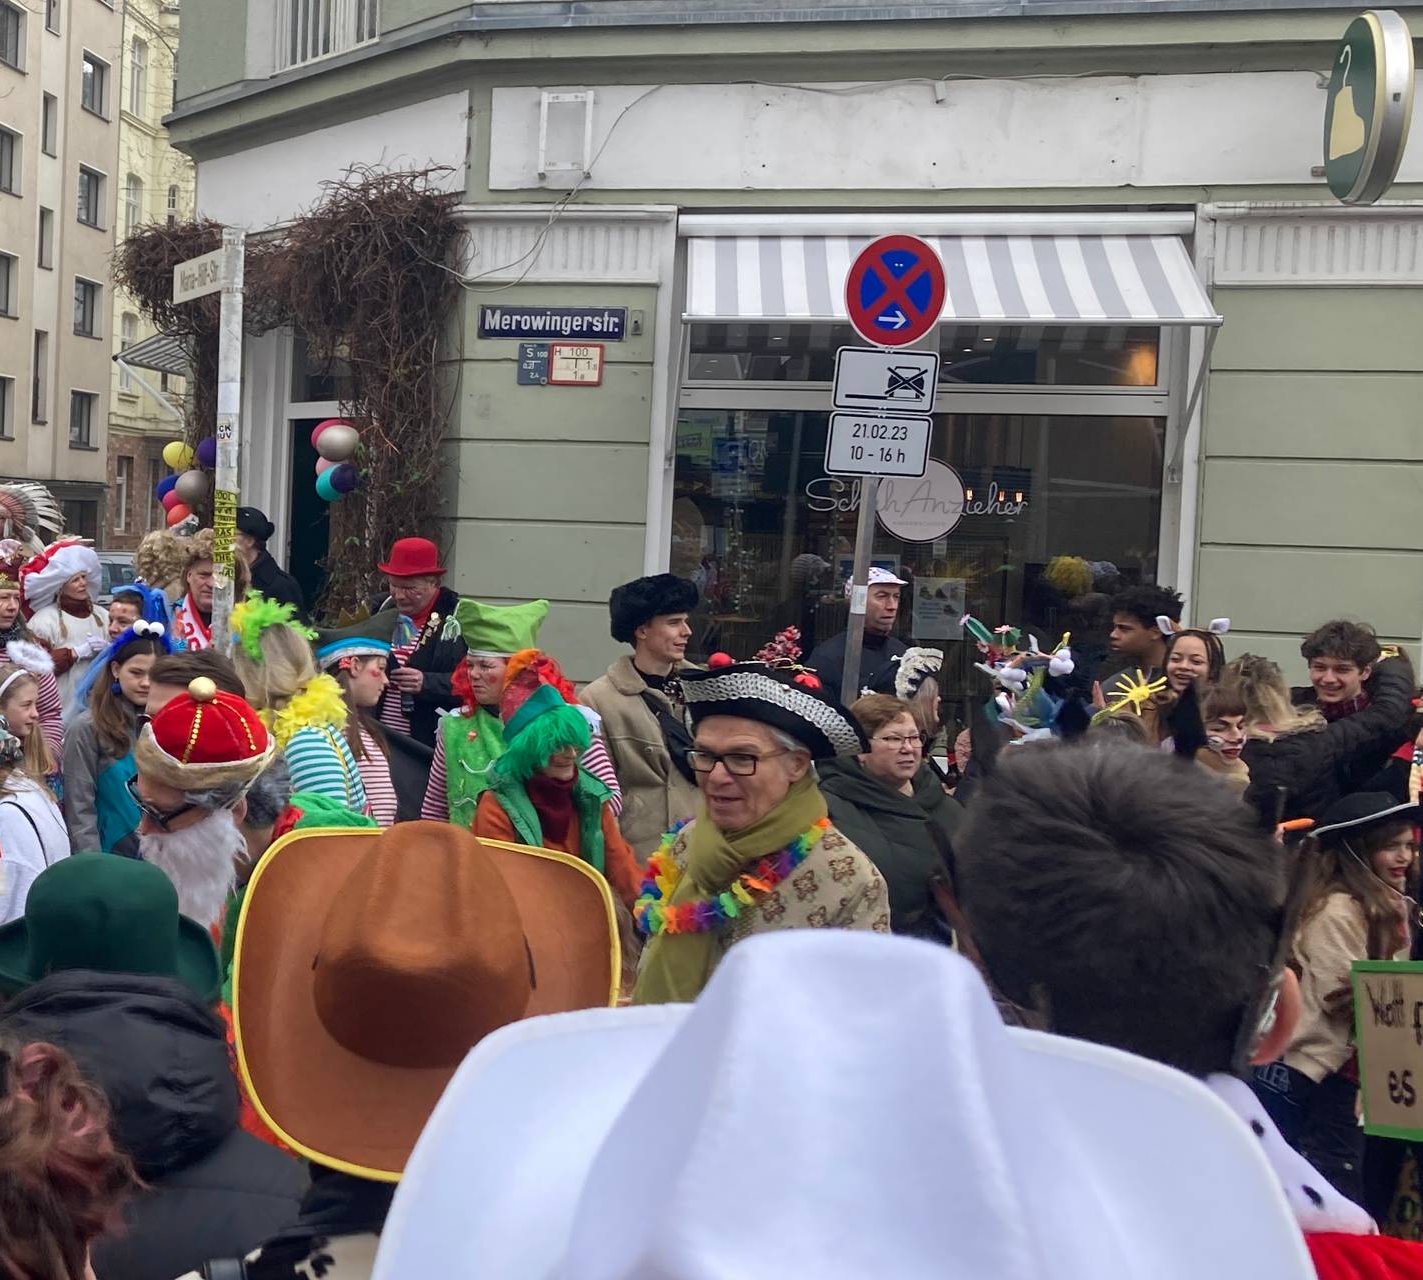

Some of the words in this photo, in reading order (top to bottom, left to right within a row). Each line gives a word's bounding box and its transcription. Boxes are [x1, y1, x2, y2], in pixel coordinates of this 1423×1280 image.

[484, 309, 620, 336] Merowingerstr.
[526, 348, 534, 358] S
[554, 348, 562, 356] H
[570, 347, 589, 357] 100
[852, 423, 908, 441] 21.02.23
[850, 446, 863, 460] 10
[879, 447, 892, 462] 16
[897, 450, 905, 463] h
[806, 478, 1029, 519] SchhAnzieher
